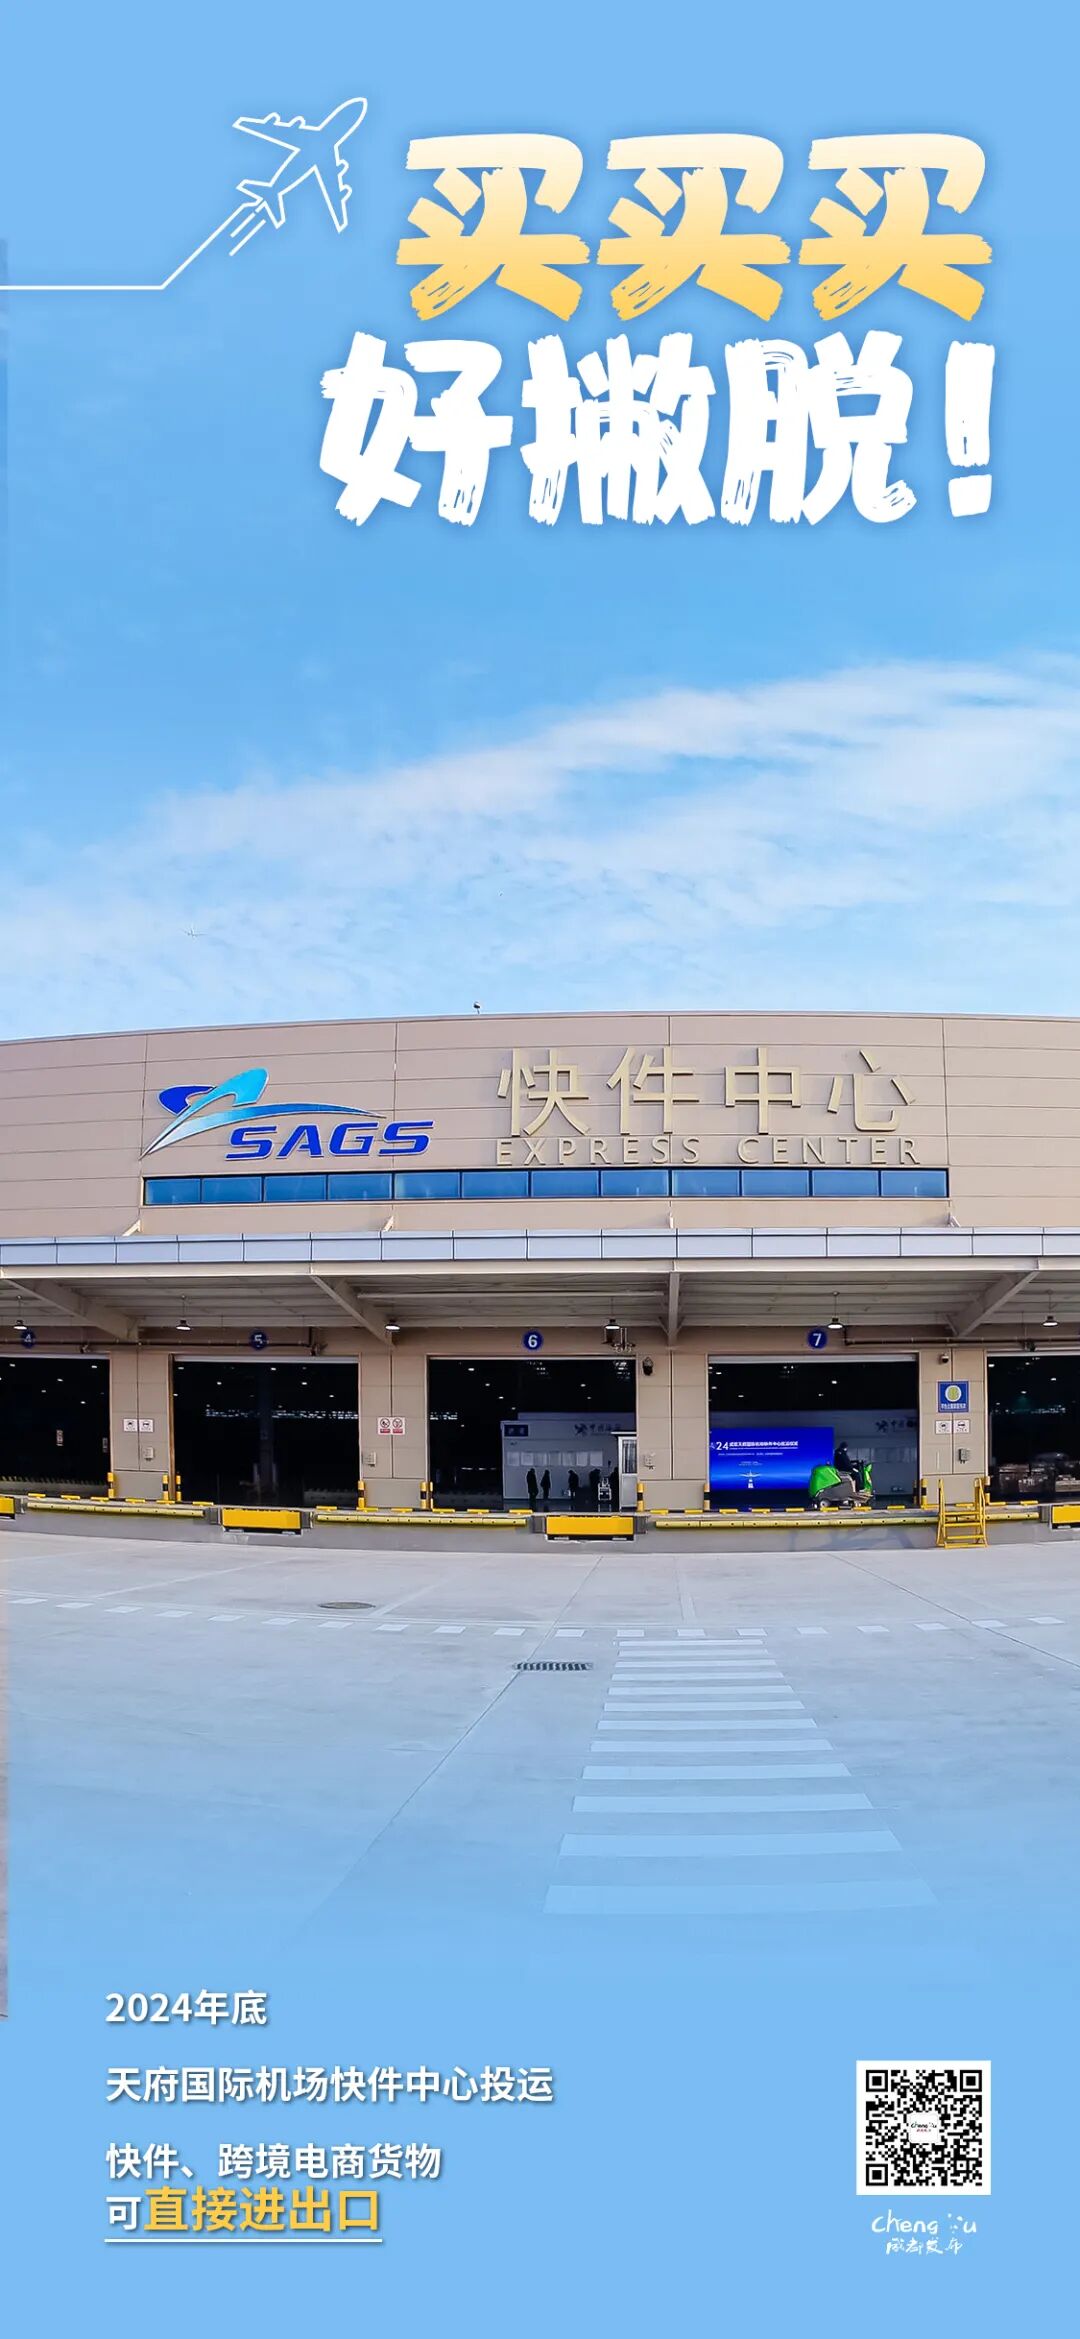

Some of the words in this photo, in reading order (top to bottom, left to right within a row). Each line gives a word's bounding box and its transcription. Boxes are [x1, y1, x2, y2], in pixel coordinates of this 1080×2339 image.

[497, 1046, 917, 1137] 快件中心
[225, 1120, 433, 1160] SAGS
[495, 1136, 701, 1167] EXPRESS
[737, 1136, 921, 1166] CENTER
[528, 1334, 538, 1348] 6
[812, 1333, 822, 1347] 7
